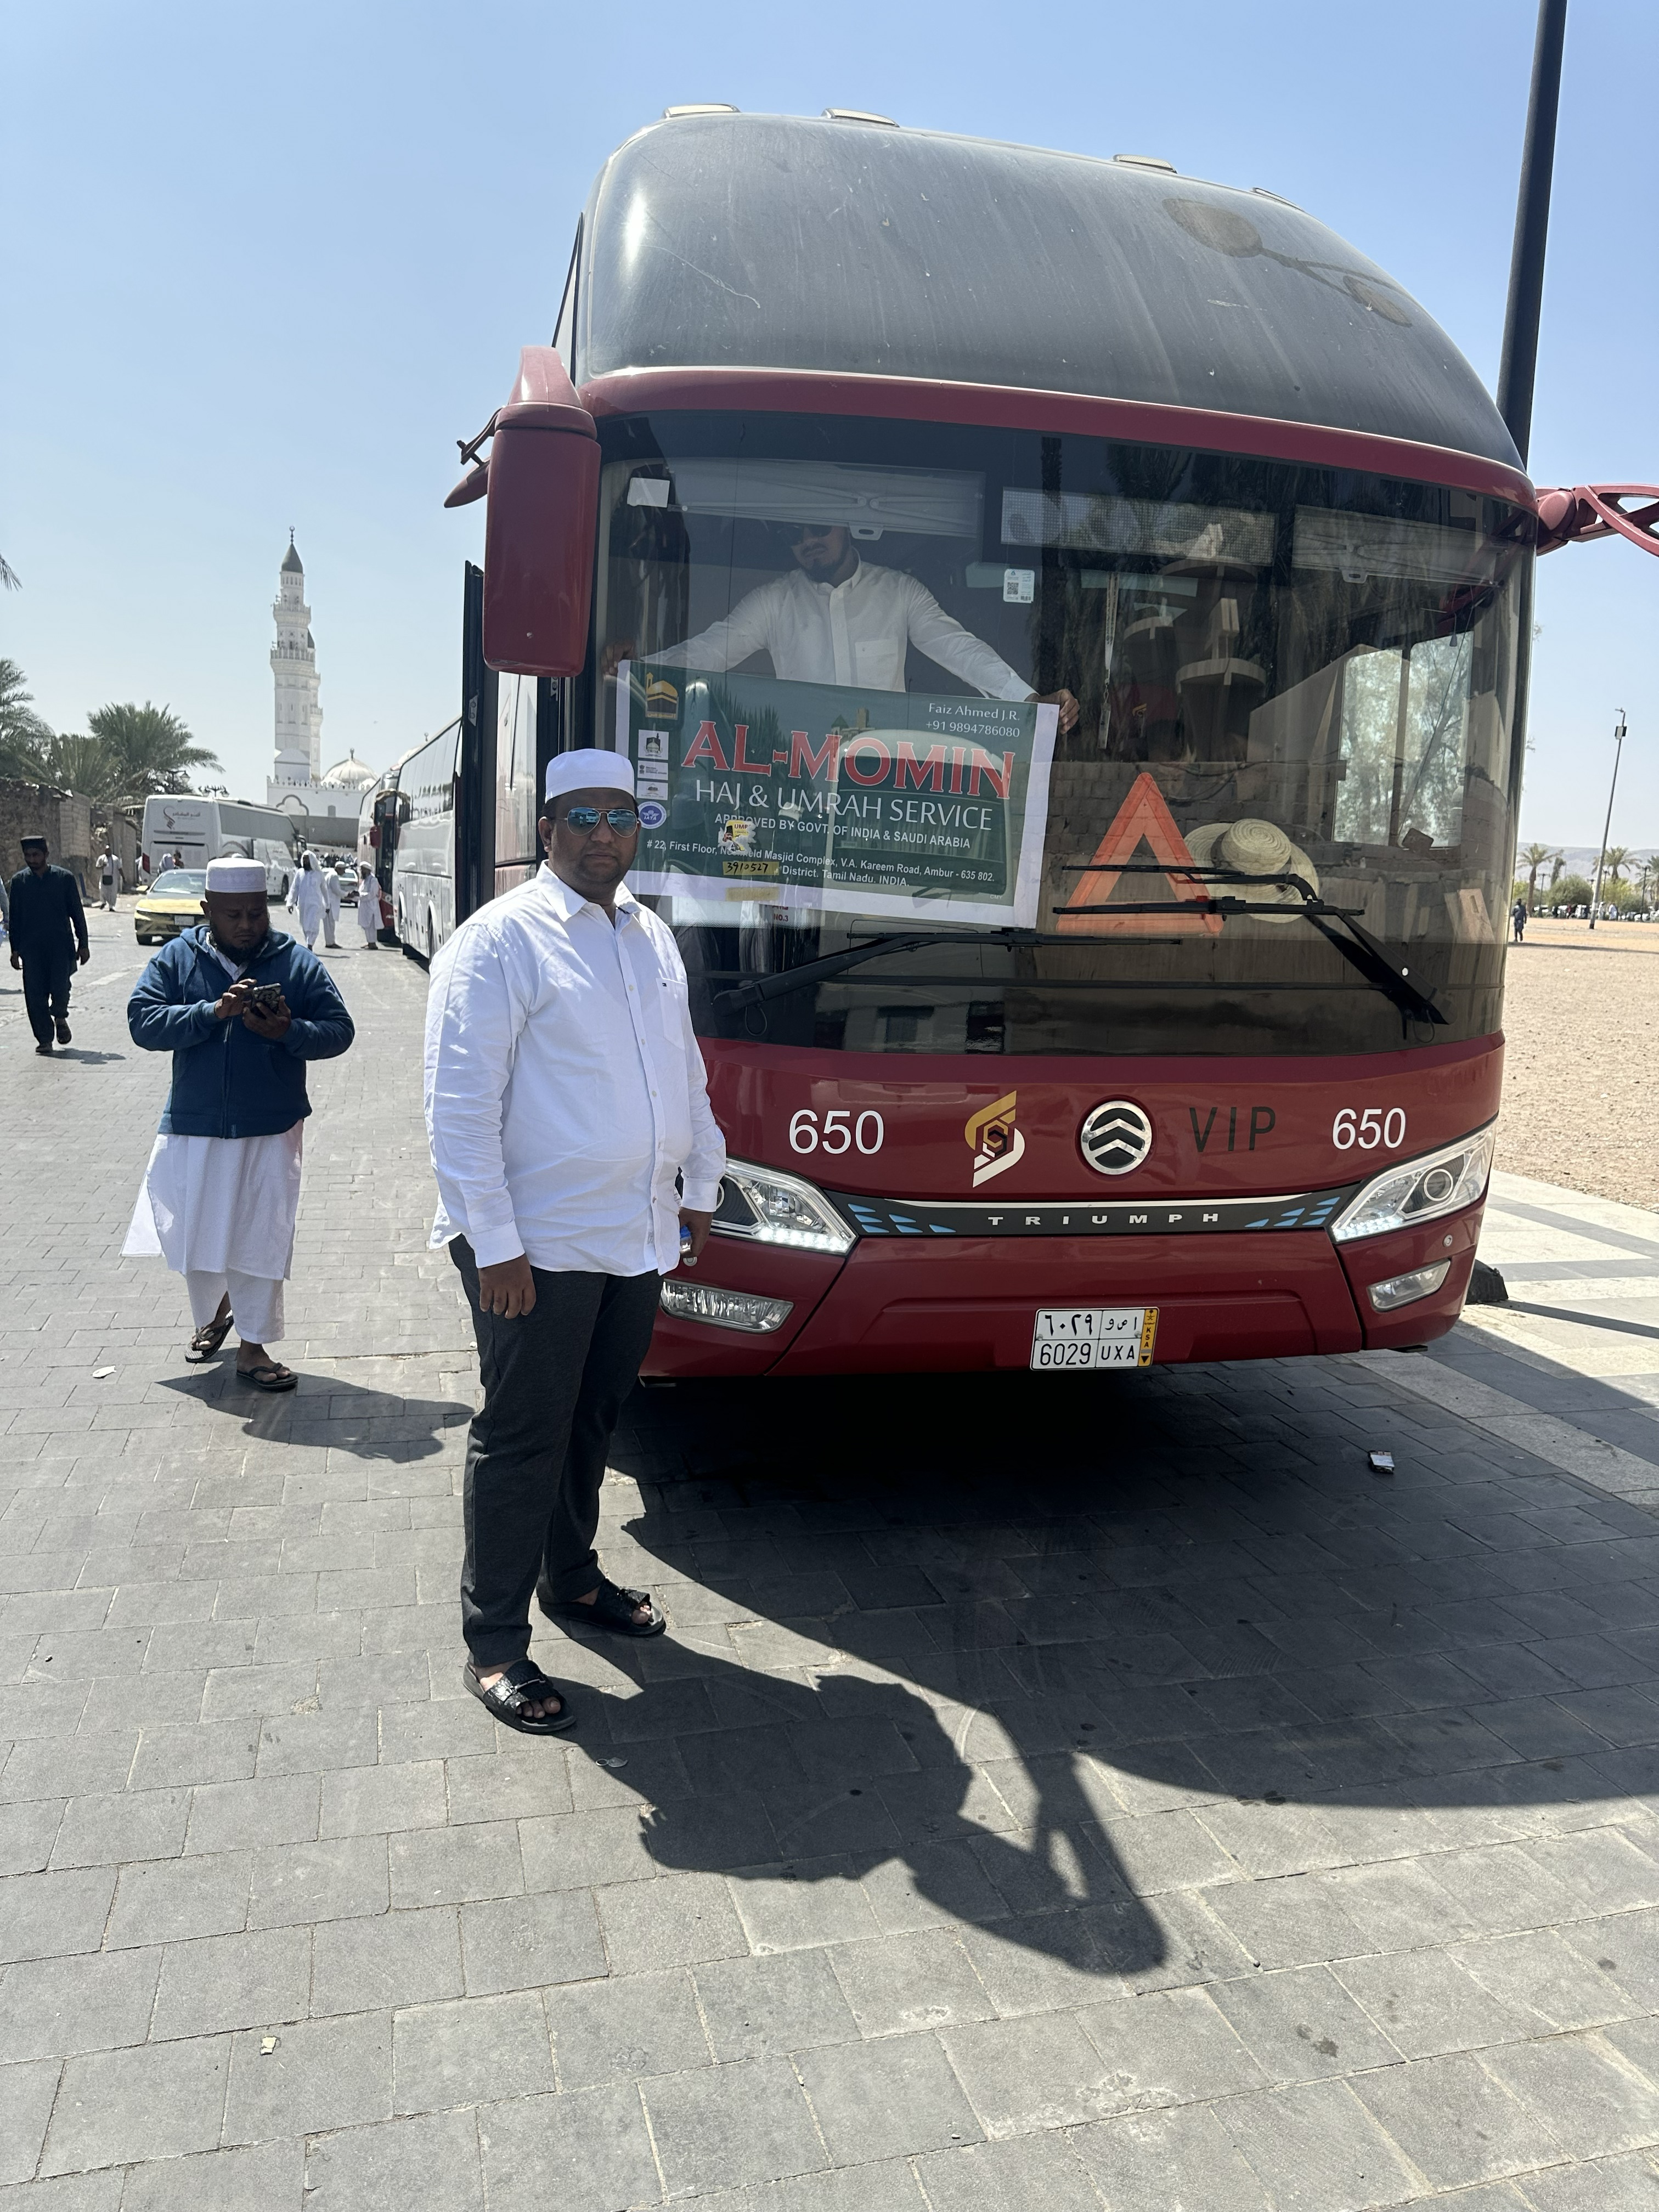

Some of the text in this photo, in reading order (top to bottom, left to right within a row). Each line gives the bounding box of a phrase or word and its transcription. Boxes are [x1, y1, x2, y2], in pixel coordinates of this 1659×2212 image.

[929, 703, 1020, 721] Faiz Ahmed J.R.
[926, 720, 1020, 738] +91 9894786080
[681, 720, 1015, 800] AL-MOMIN
[696, 779, 741, 810] HAJ
[749, 785, 769, 808] &
[777, 787, 882, 820] UMRAH
[889, 799, 994, 831] SERVICE
[780, 820, 795, 831] BY
[797, 822, 830, 834] GOVT.
[833, 825, 848, 836] OF
[851, 827, 881, 839] INDIA
[883, 830, 891, 841] &
[894, 832, 927, 844] SAUDI
[929, 836, 970, 849] ARABIA
[647, 839, 653, 848] #
[654, 840, 667, 850] 22,
[669, 841, 690, 851] First
[692, 843, 718, 856] Floor,
[764, 850, 794, 863] Masjid
[796, 853, 838, 867] Complex,
[840, 858, 858, 868] V.A.
[860, 860, 894, 872] Kareem
[896, 863, 922, 876] Road,
[924, 867, 953, 878] Ambur
[961, 870, 975, 879] 635
[978, 871, 995, 882] 802.
[725, 861, 769, 874] 3910527
[782, 865, 910, 887] District. Tamil Nadu. INDIA.
[774, 913, 789, 922] NO.3
[788, 1109, 885, 1154] 650
[1189, 1106, 1276, 1153] VIP
[1332, 1107, 1407, 1150] 650
[988, 1212, 1219, 1226] TRIUMPH
[1045, 1313, 1093, 1336] ٦٠٢٩
[1040, 1342, 1091, 1365] 6029
[1101, 1345, 1135, 1361] UXA
